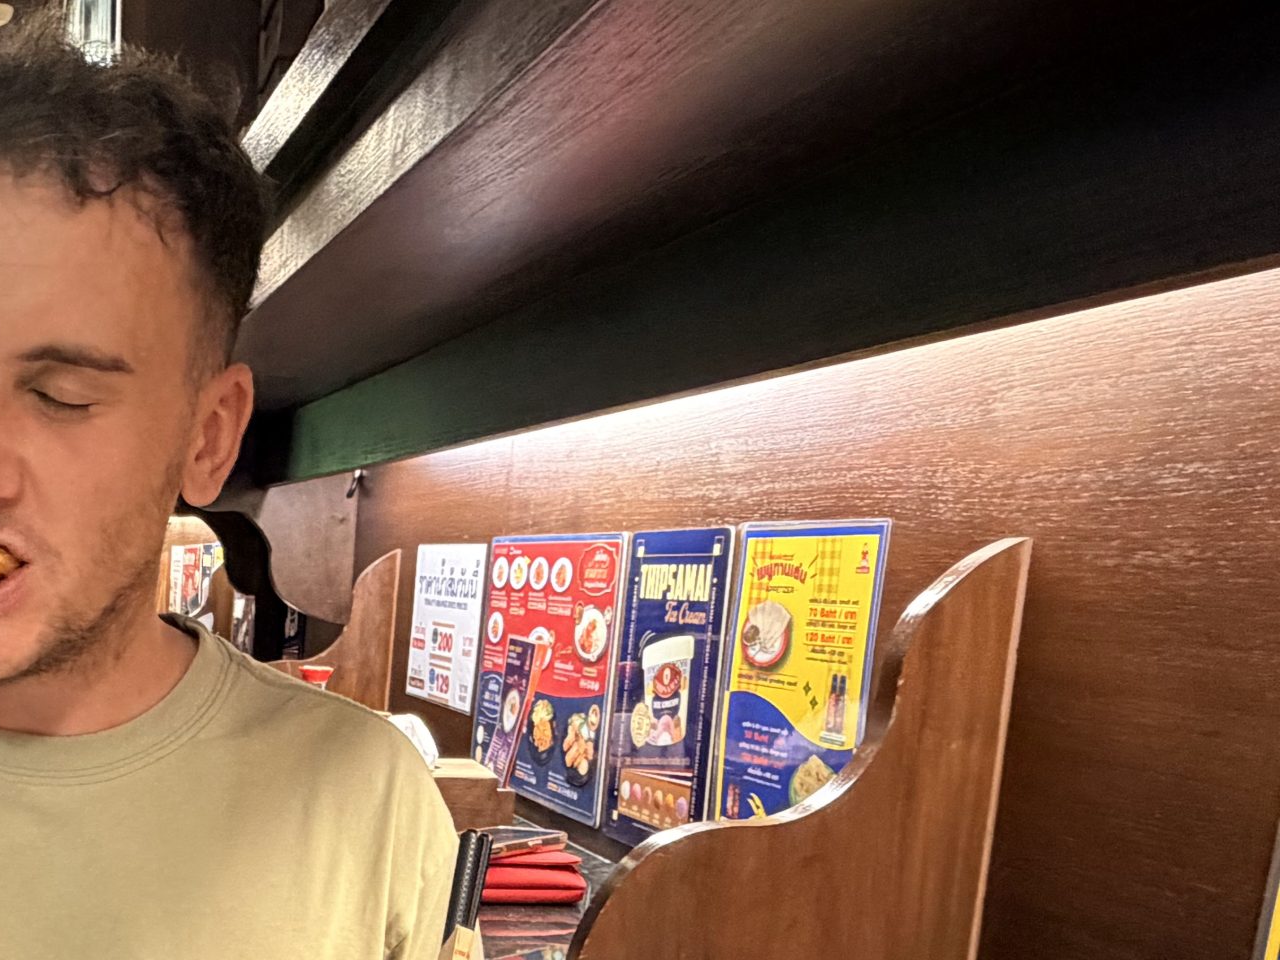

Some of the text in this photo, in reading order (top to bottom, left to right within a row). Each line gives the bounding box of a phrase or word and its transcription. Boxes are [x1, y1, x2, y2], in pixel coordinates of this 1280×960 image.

[640, 564, 712, 602] THIPSAMAI
[679, 602, 706, 625] Cream
[438, 631, 453, 653] 200
[436, 673, 450, 694] 129
